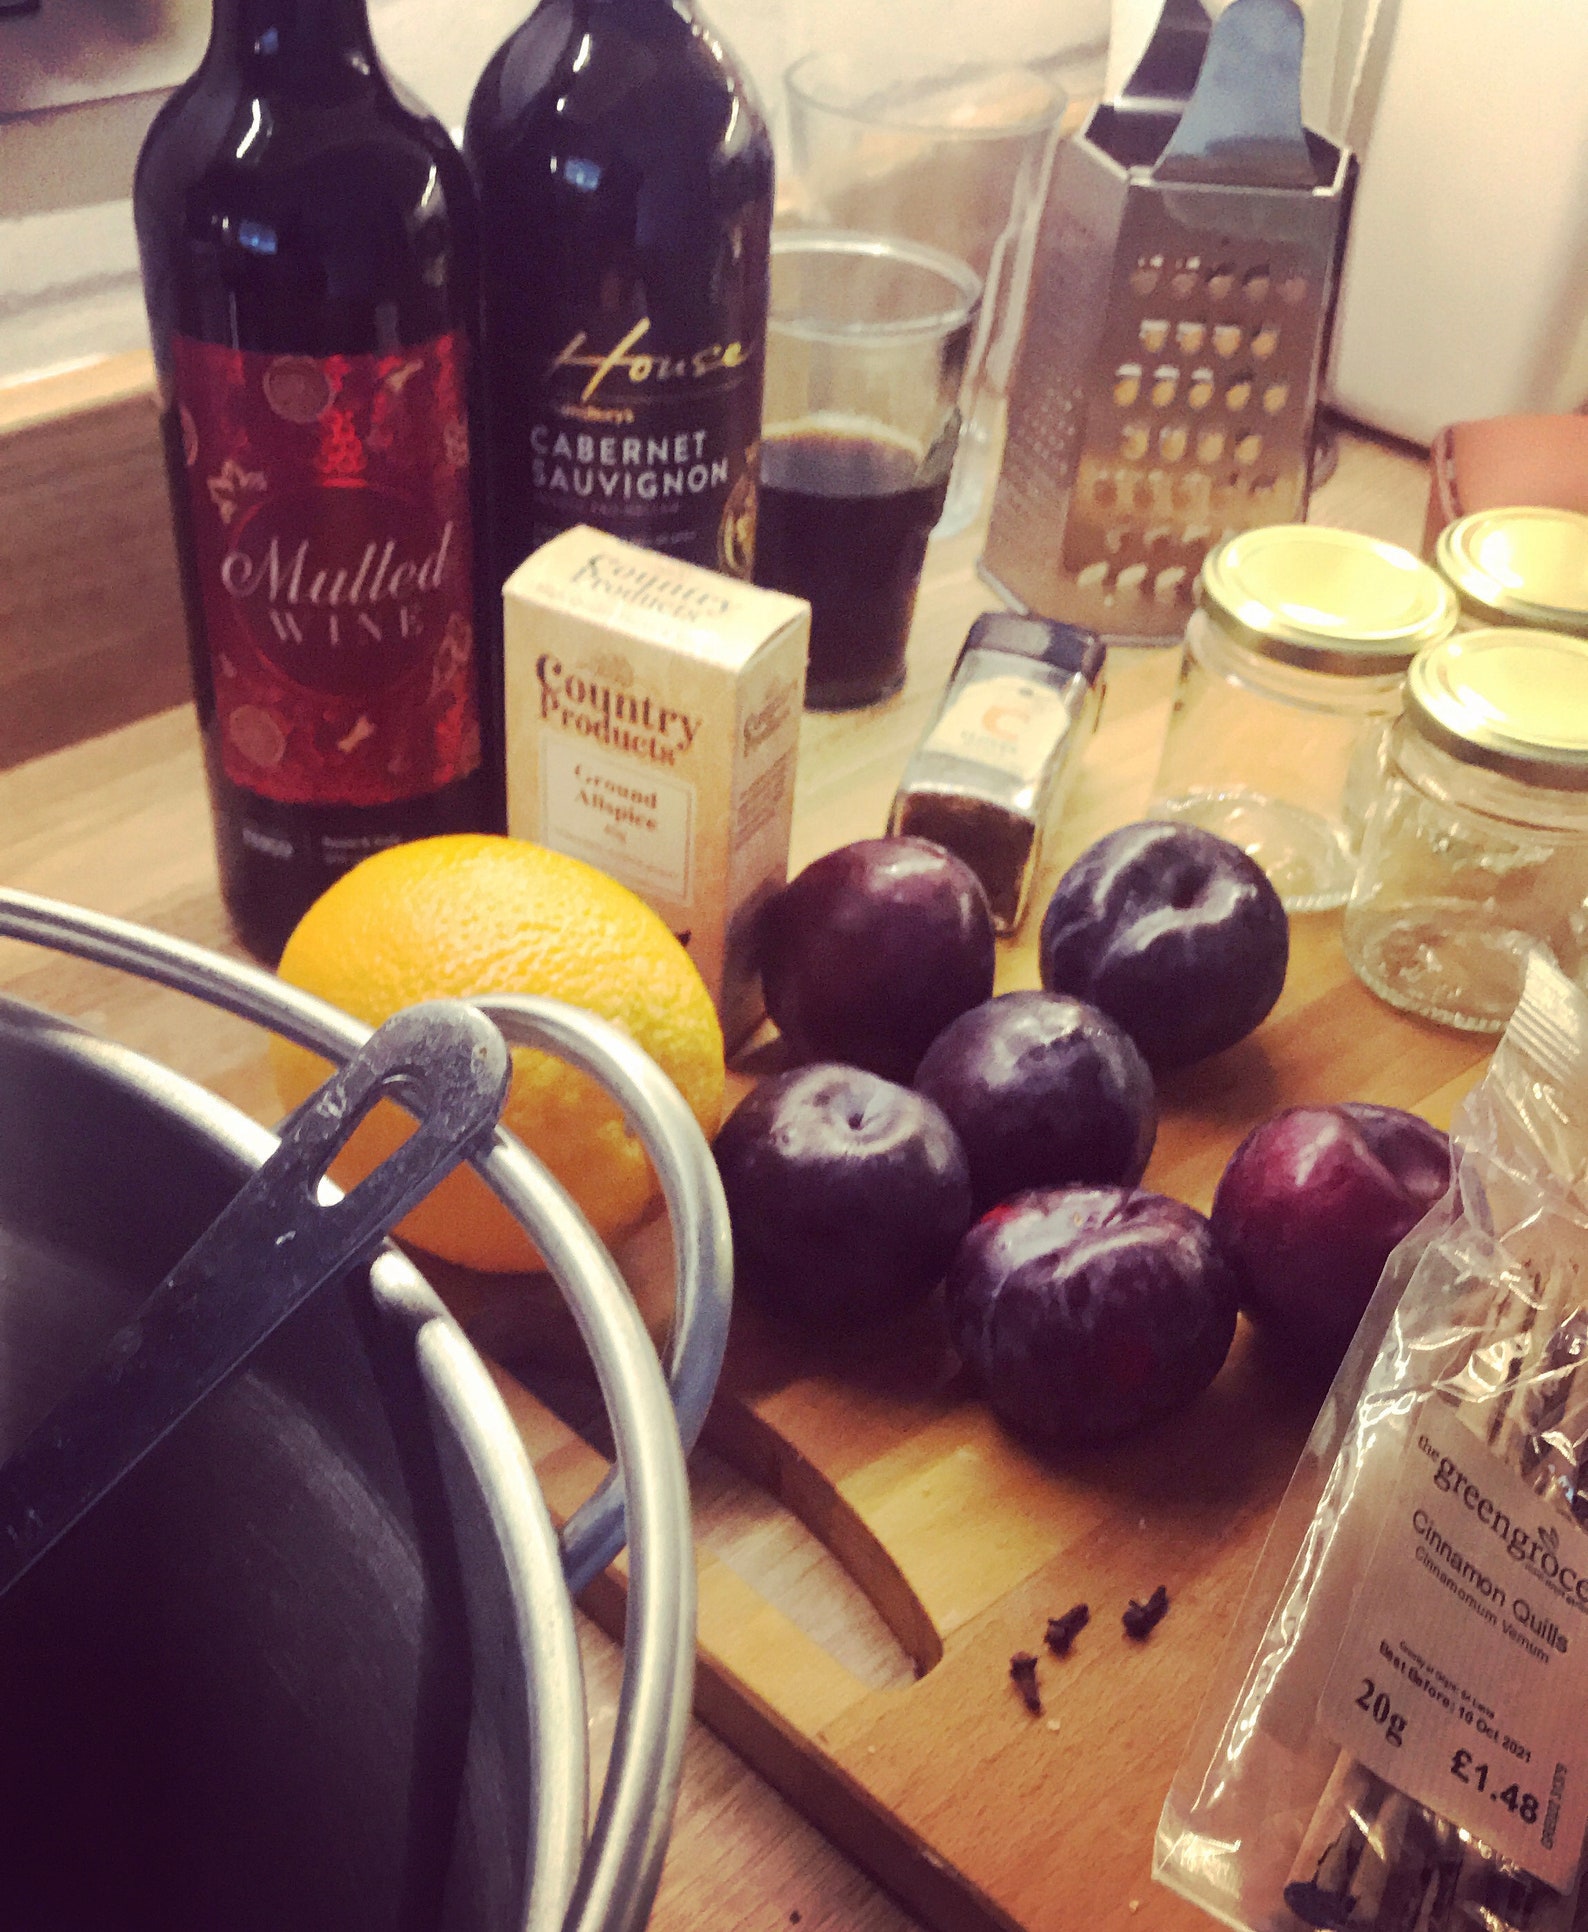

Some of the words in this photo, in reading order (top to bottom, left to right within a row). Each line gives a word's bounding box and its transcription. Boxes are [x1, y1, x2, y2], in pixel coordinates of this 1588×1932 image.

[530, 425, 708, 465] CABERNET
[531, 457, 729, 500] SAUVIGNON
[221, 519, 454, 606] Mulled
[269, 602, 426, 646] WINE
[535, 653, 703, 754] Country
[539, 682, 676, 767] Products
[574, 763, 658, 810] Ground
[575, 789, 657, 830] Allspice
[1417, 1434, 1440, 1463] the
[1412, 1508, 1506, 1607] Cinnamon
[1512, 1598, 1568, 1653] Quills
[1414, 1545, 1497, 1626] Cinnamomum
[1354, 1677, 1408, 1749] 20g
[1379, 1639, 1406, 1675] Best
[1475, 1717, 1500, 1744] Oct
[1501, 1734, 1532, 1764] 2021
[1450, 1748, 1540, 1825] £1.48
